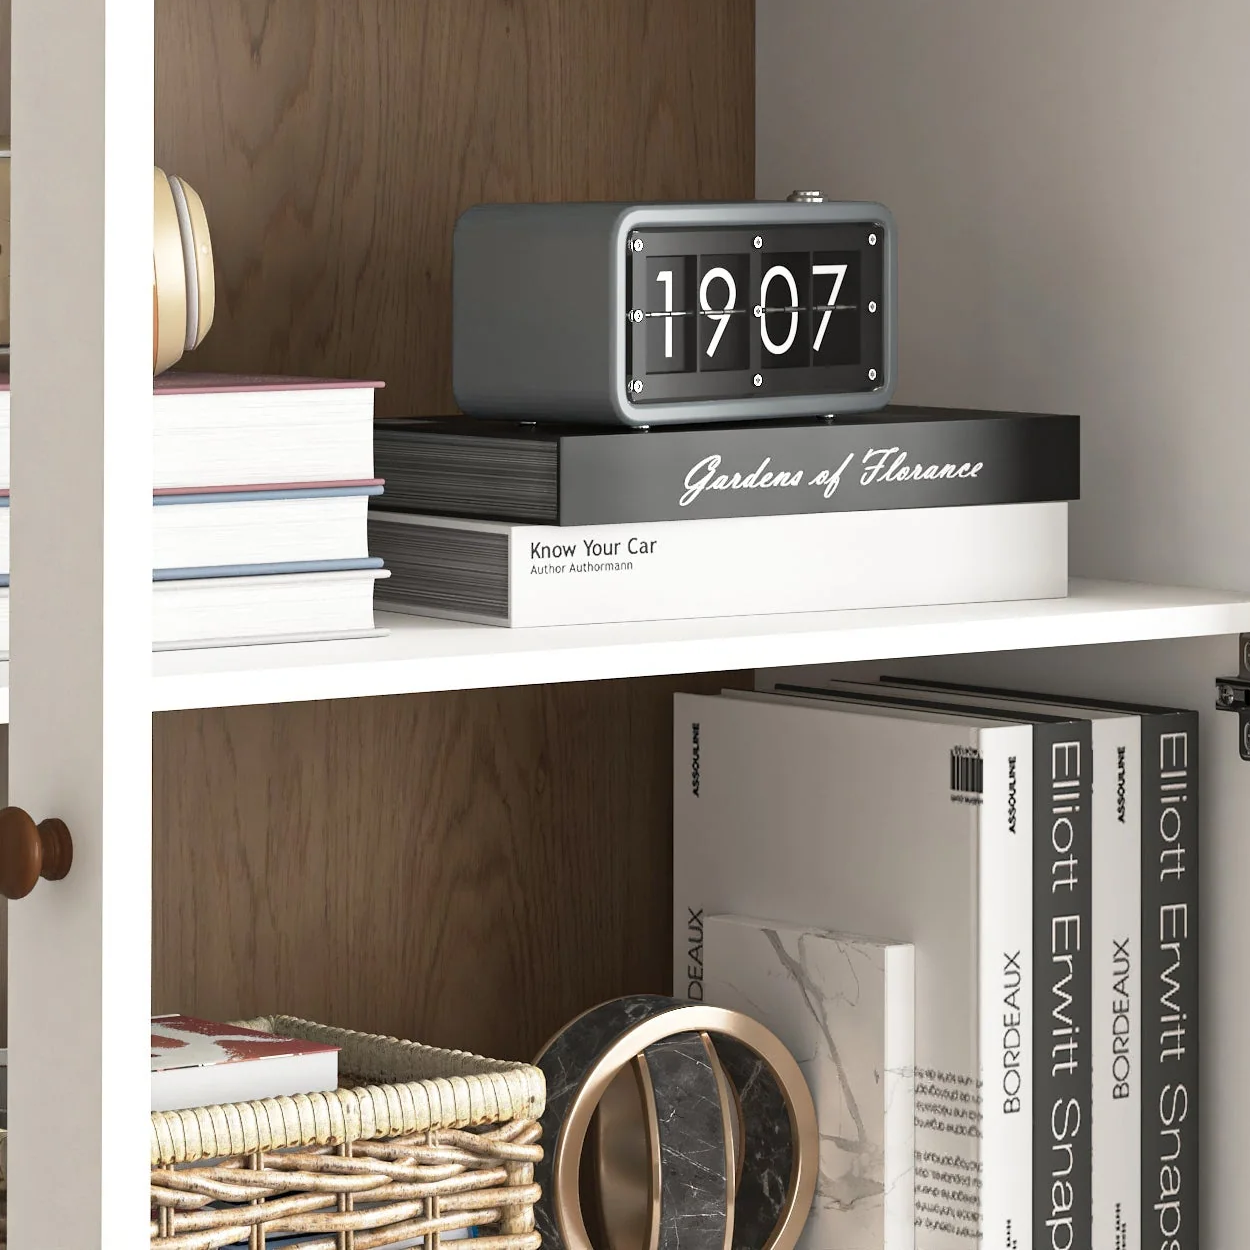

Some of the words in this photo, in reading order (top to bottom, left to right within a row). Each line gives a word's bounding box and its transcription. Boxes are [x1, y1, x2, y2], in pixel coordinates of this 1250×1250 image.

[655, 262, 849, 359] 1907
[679, 453, 805, 508] Gardens
[807, 452, 854, 503] of
[860, 444, 985, 488] Florance
[530, 540, 578, 562] Know
[582, 538, 623, 561] Your
[626, 536, 658, 557] Car
[530, 562, 566, 576] Author
[568, 560, 634, 575] Authormann
[691, 722, 700, 798] ASSOULINE
[1007, 756, 1017, 835] ASSOULINE
[1116, 746, 1126, 824] ASSOULINE
[1157, 731, 1189, 882] Elliott
[1051, 740, 1082, 895] Elliott
[688, 906, 704, 1002] DEAUX
[1051, 913, 1082, 1078] Erwitt
[1157, 903, 1189, 1063] Erwitt
[1002, 950, 1022, 1115] BORDEAUX
[1112, 937, 1131, 1100] BORDEAUX
